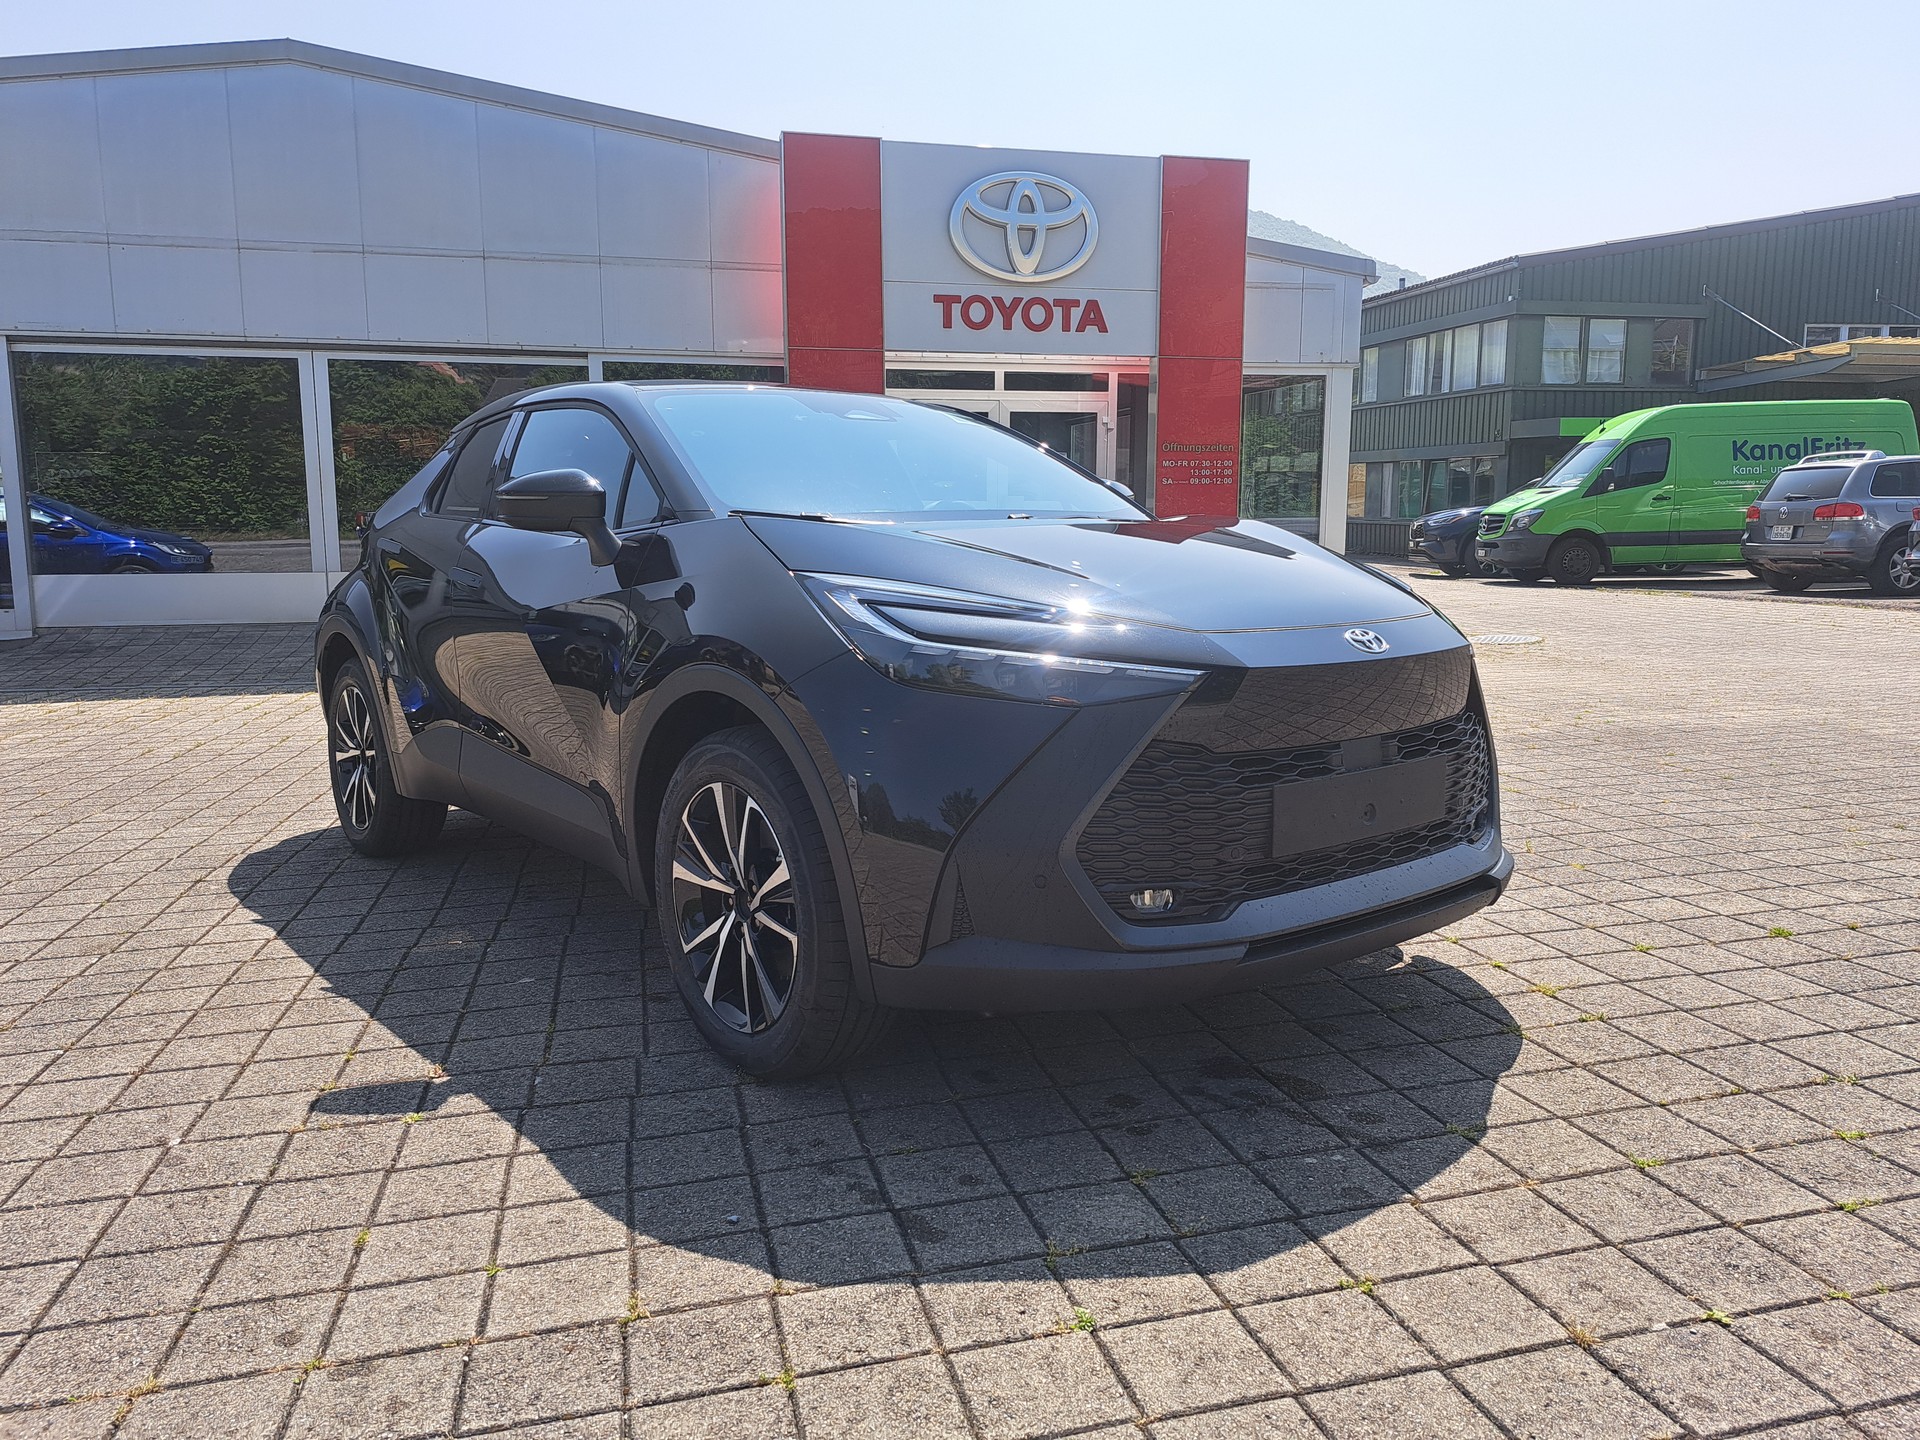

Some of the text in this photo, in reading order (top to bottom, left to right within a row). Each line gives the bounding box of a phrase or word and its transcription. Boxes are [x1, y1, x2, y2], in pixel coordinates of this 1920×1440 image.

[933, 294, 1109, 333] TOYOTA
[1162, 441, 1234, 454] Öffnungszeiten
[1732, 436, 1866, 461] KanalFritz
[1190, 468, 1233, 476] 13:00-17:00
[1733, 464, 1790, 475] Kanal- un
